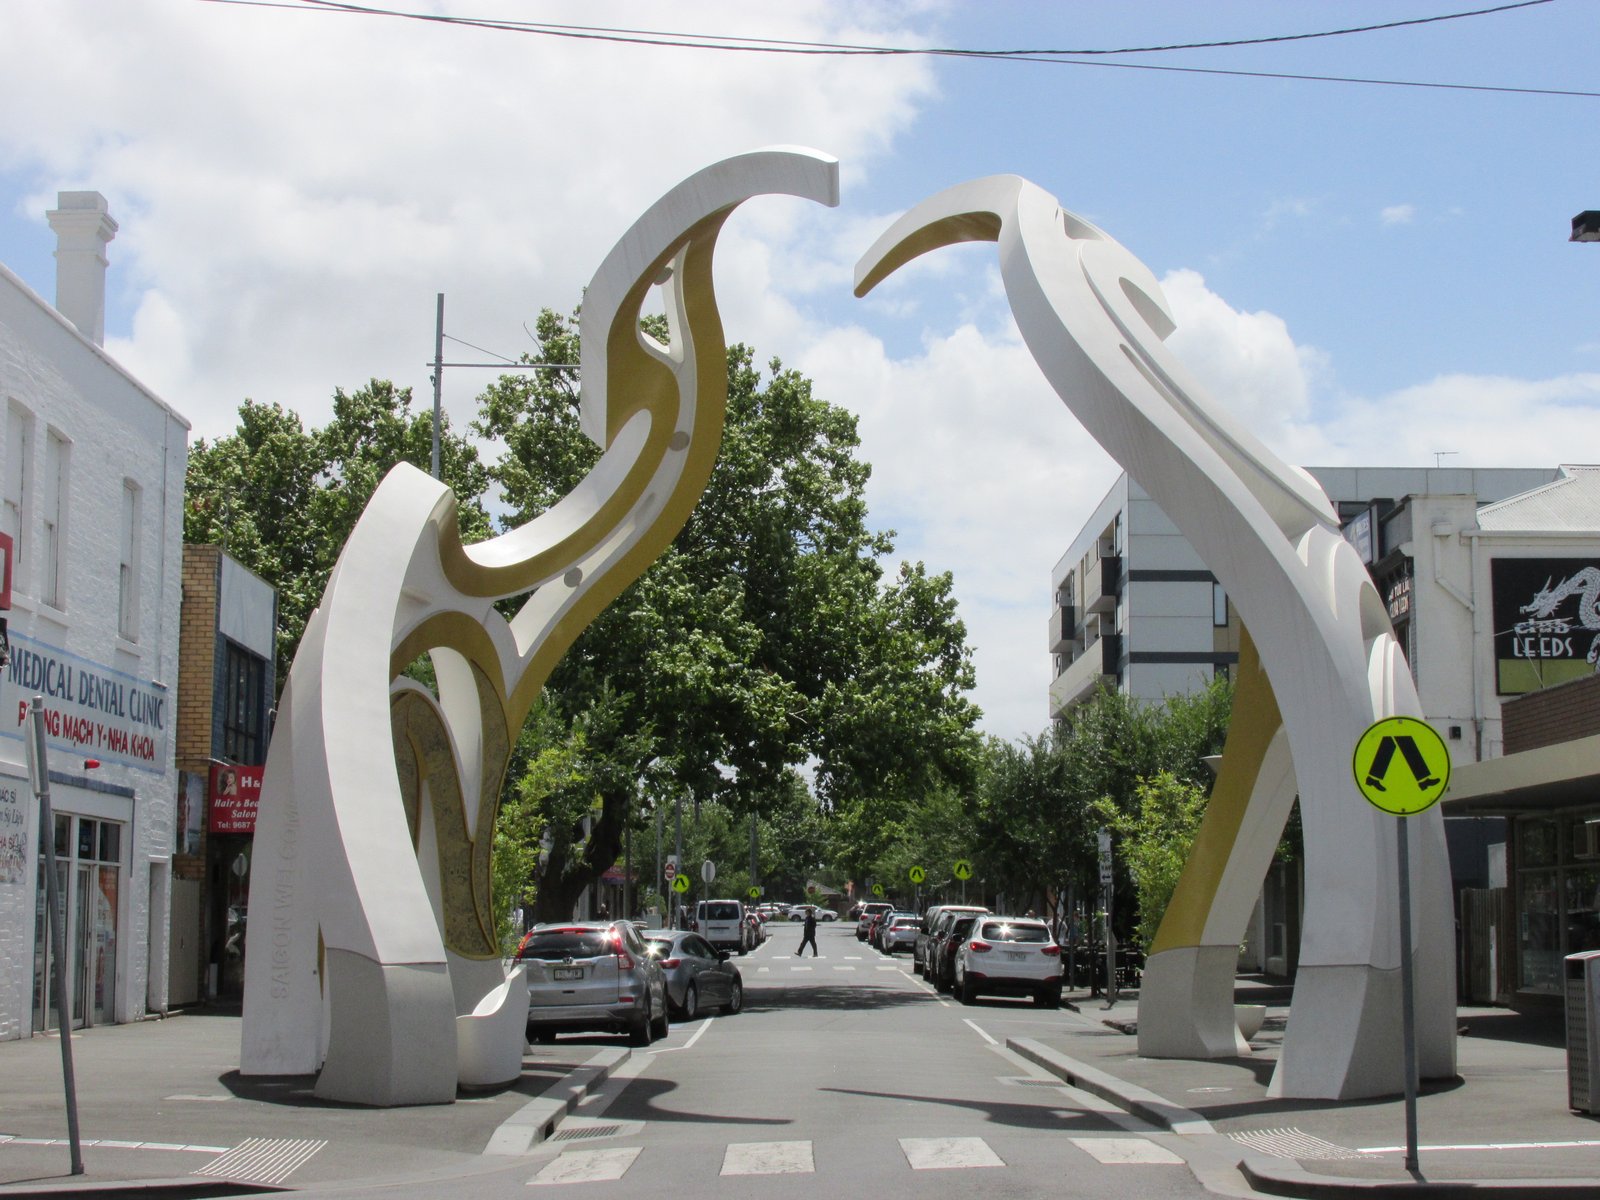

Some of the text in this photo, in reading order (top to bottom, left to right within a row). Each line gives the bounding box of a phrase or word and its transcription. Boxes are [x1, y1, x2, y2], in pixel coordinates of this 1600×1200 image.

[1513, 637, 1573, 657] LEEDS
[8, 645, 164, 730] MEDICAL DENTAL CLINIC
[18, 701, 60, 737] PNG
[131, 733, 154, 761] KHOA
[214, 799, 234, 807] Hair
[244, 799, 259, 807] Bea
[231, 810, 256, 818] Salon
[271, 917, 292, 1000] SAIGON
